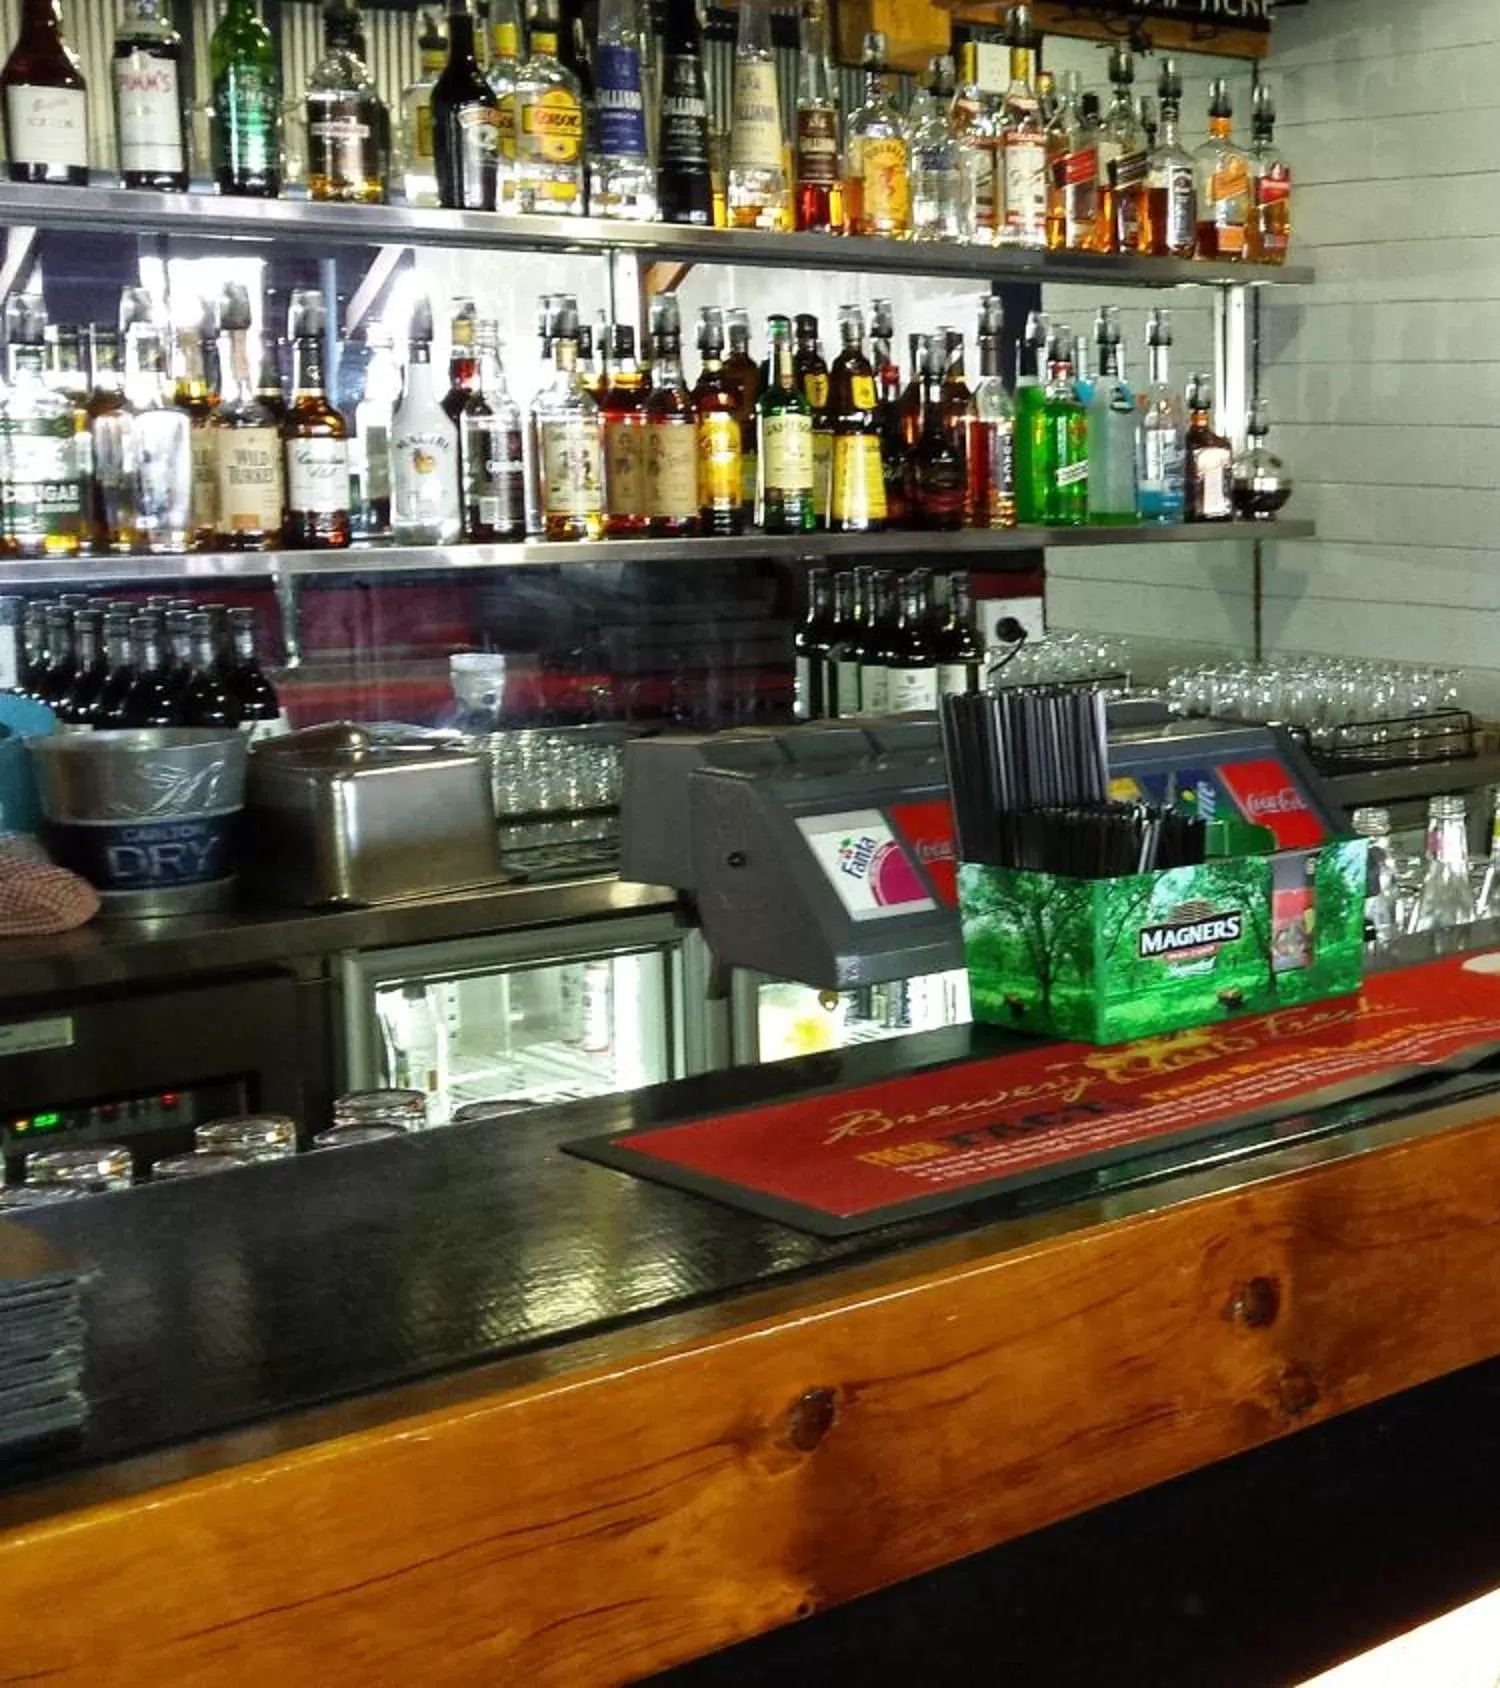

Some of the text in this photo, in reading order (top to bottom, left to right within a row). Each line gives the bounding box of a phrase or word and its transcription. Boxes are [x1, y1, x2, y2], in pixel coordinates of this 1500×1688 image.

[107, 836, 219, 877] DRY
[841, 836, 878, 879] Fanta
[1142, 916, 1239, 954] MAGNERS
